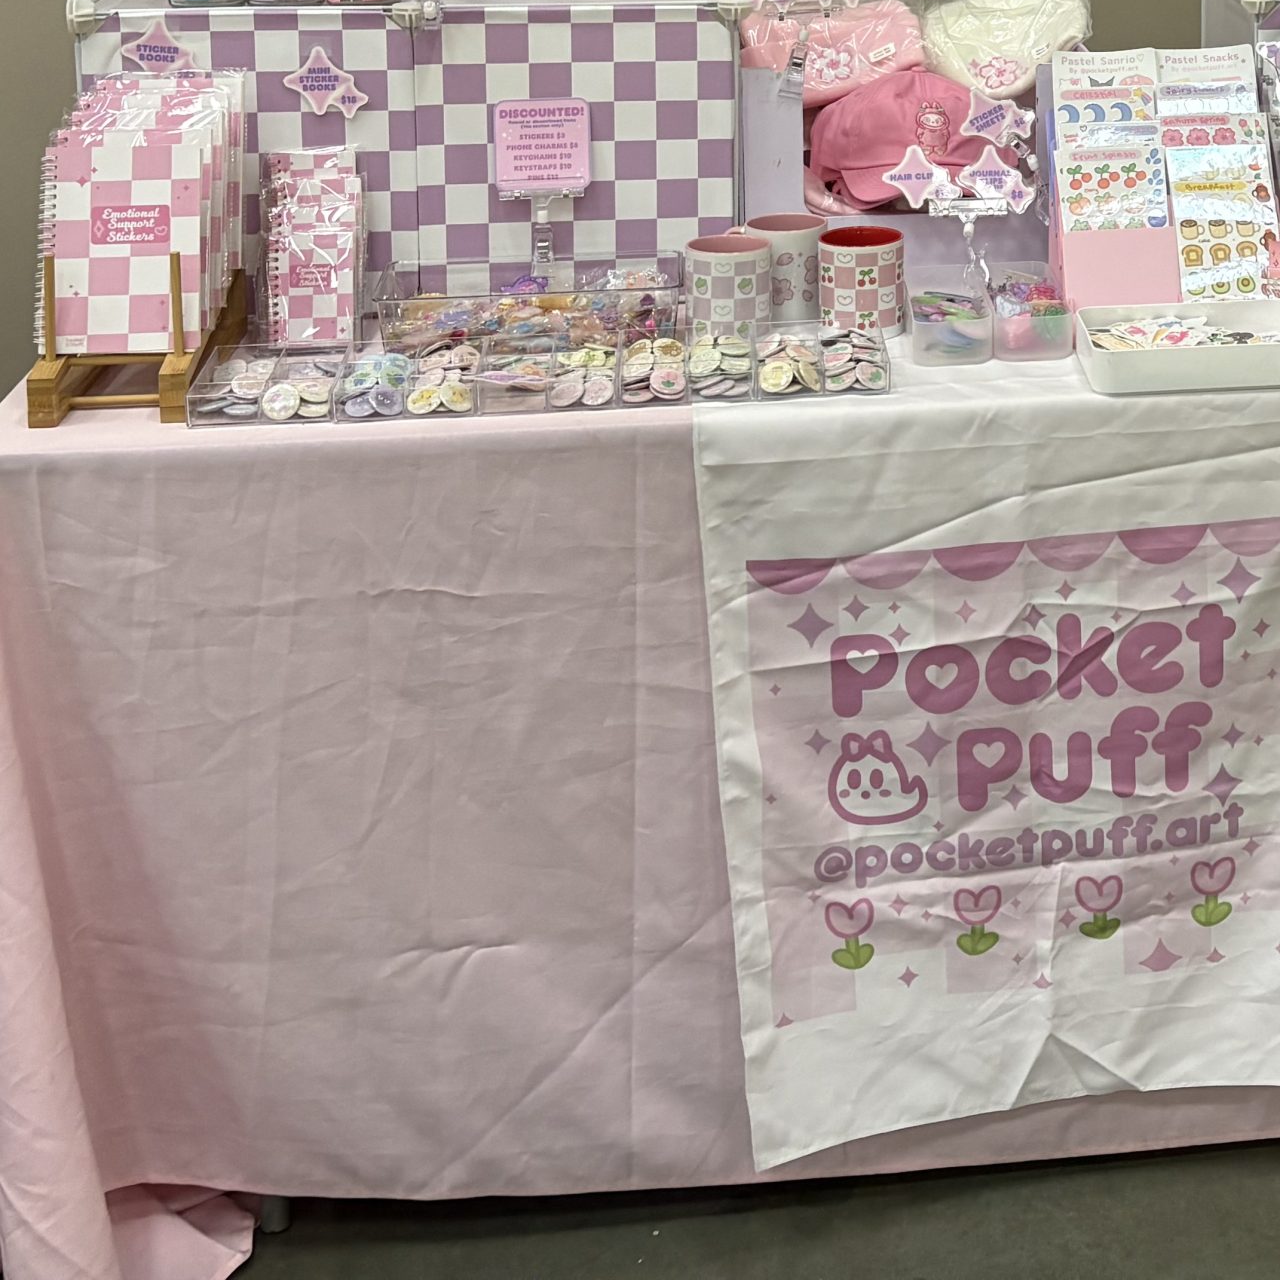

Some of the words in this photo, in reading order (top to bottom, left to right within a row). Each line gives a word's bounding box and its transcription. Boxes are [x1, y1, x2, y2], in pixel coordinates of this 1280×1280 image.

[136, 43, 179, 55] STICKER
[139, 53, 176, 63] BOOKS
[1061, 56, 1095, 66] Pastel
[1100, 55, 1136, 66] Sanrio
[1165, 55, 1198, 65] Pastel
[1203, 52, 1239, 63] Snacks
[307, 67, 330, 75] MINI
[299, 75, 339, 84] STICKER
[302, 83, 336, 92] BOOKS
[499, 106, 585, 119] DISCOUNTED!
[969, 104, 1005, 128] STICKER
[975, 112, 1006, 133] SHEETS
[519, 133, 555, 141] STICKERS
[506, 143, 533, 151] PHONE
[535, 142, 568, 151] CHARMS
[513, 153, 558, 162] KEYCHAINS
[513, 164, 558, 172] KEYSTRAPS
[889, 173, 913, 182] HAIR
[979, 177, 1003, 185] LIPS
[102, 207, 160, 220] Emotional
[108, 218, 155, 234] Support
[107, 230, 155, 242] Stickers
[829, 603, 1237, 719] Pocket
[955, 701, 1213, 814] Puff
[813, 802, 1245, 888] @pocketpuff.art
